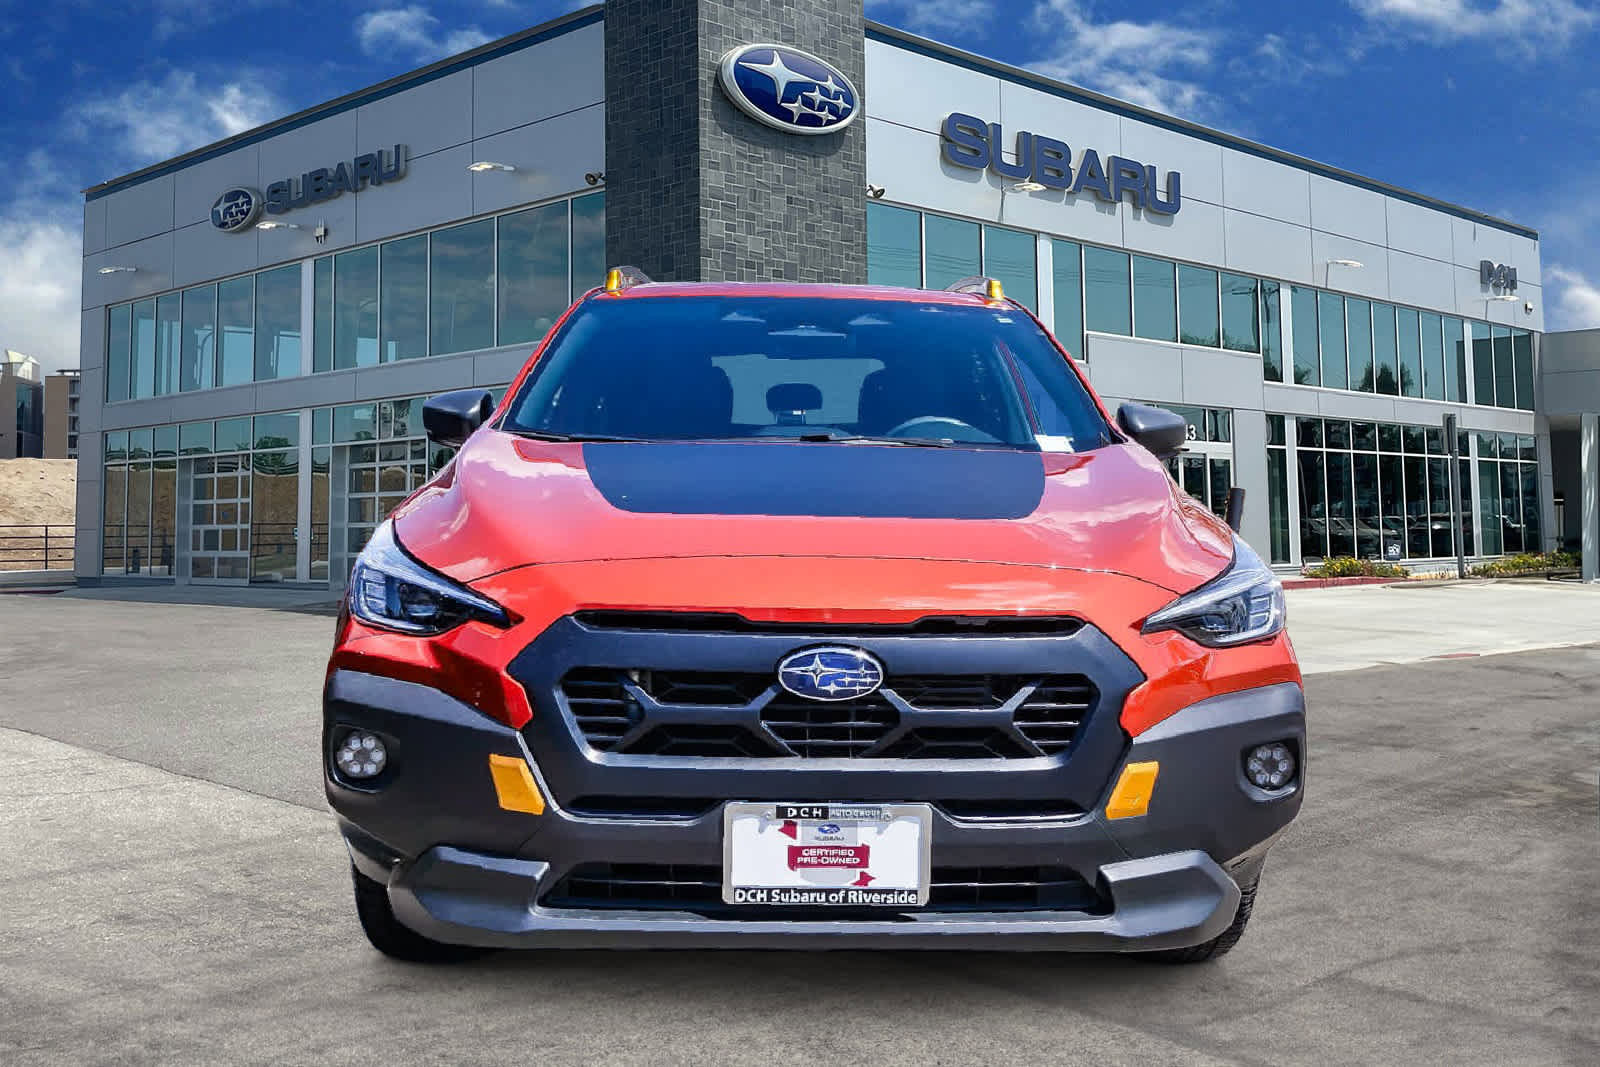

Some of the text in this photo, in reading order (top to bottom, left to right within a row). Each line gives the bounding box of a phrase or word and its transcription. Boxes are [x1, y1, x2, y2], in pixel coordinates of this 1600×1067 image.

[941, 112, 1181, 215] SUBARU
[266, 143, 408, 214] SUBARU
[787, 808, 822, 818] DCH
[802, 848, 855, 857] CERTIFIED
[797, 856, 861, 865] PRE-OWNED
[734, 889, 917, 904] DCH Subaru of Riverside
